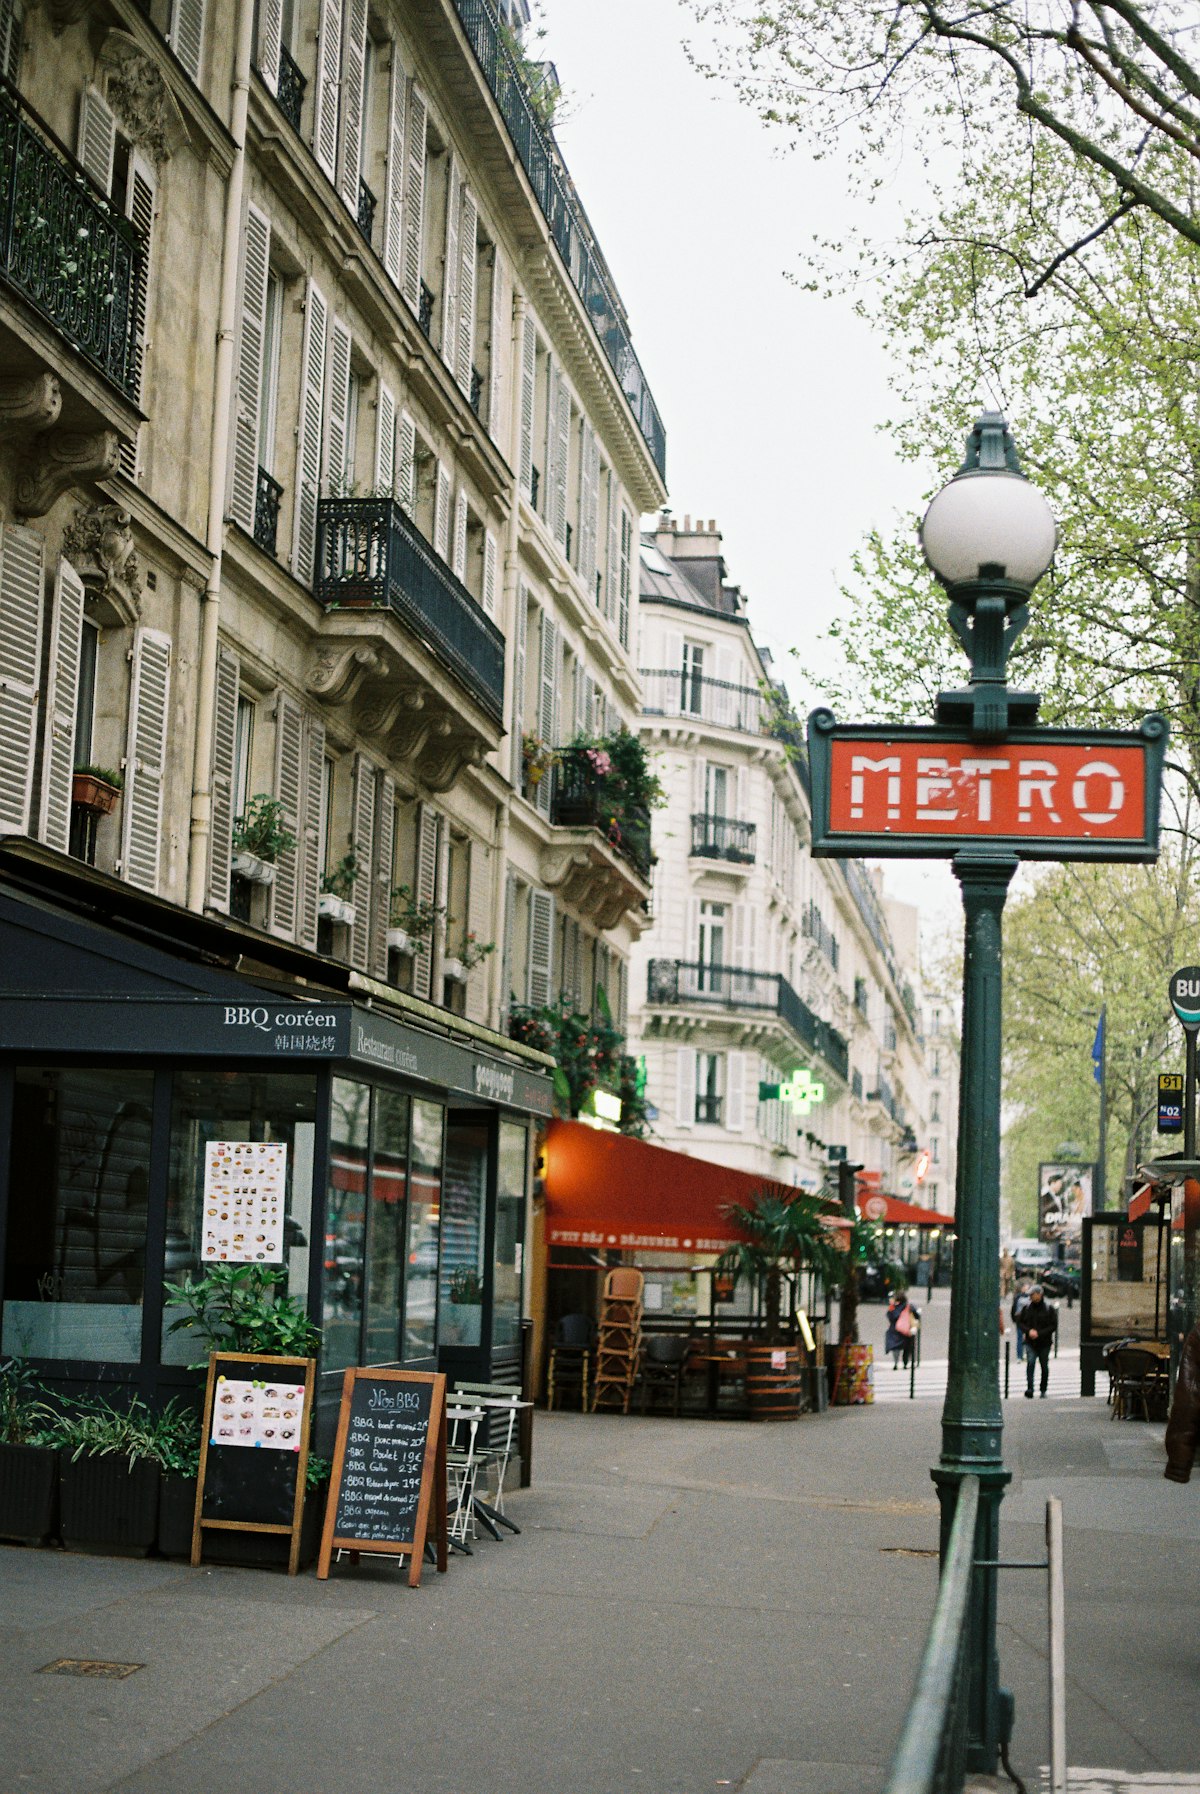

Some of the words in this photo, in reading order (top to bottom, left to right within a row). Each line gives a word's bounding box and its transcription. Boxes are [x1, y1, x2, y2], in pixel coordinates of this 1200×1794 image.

[850, 755, 1125, 824] METRO
[223, 1006, 272, 1032] BBQ
[275, 1010, 337, 1027] coréen
[275, 1034, 337, 1052] 韩国烧烤
[357, 1025, 394, 1063] Restaurant
[1163, 1076, 1178, 1088] 91
[368, 1388, 395, 1407] Nos
[396, 1392, 420, 1410] BBQ
[374, 1436, 391, 1448] porc
[372, 1448, 399, 1461] Poulet
[402, 1451, 422, 1463] 19€
[398, 1463, 419, 1474] 23€
[402, 1478, 421, 1489] 19€
